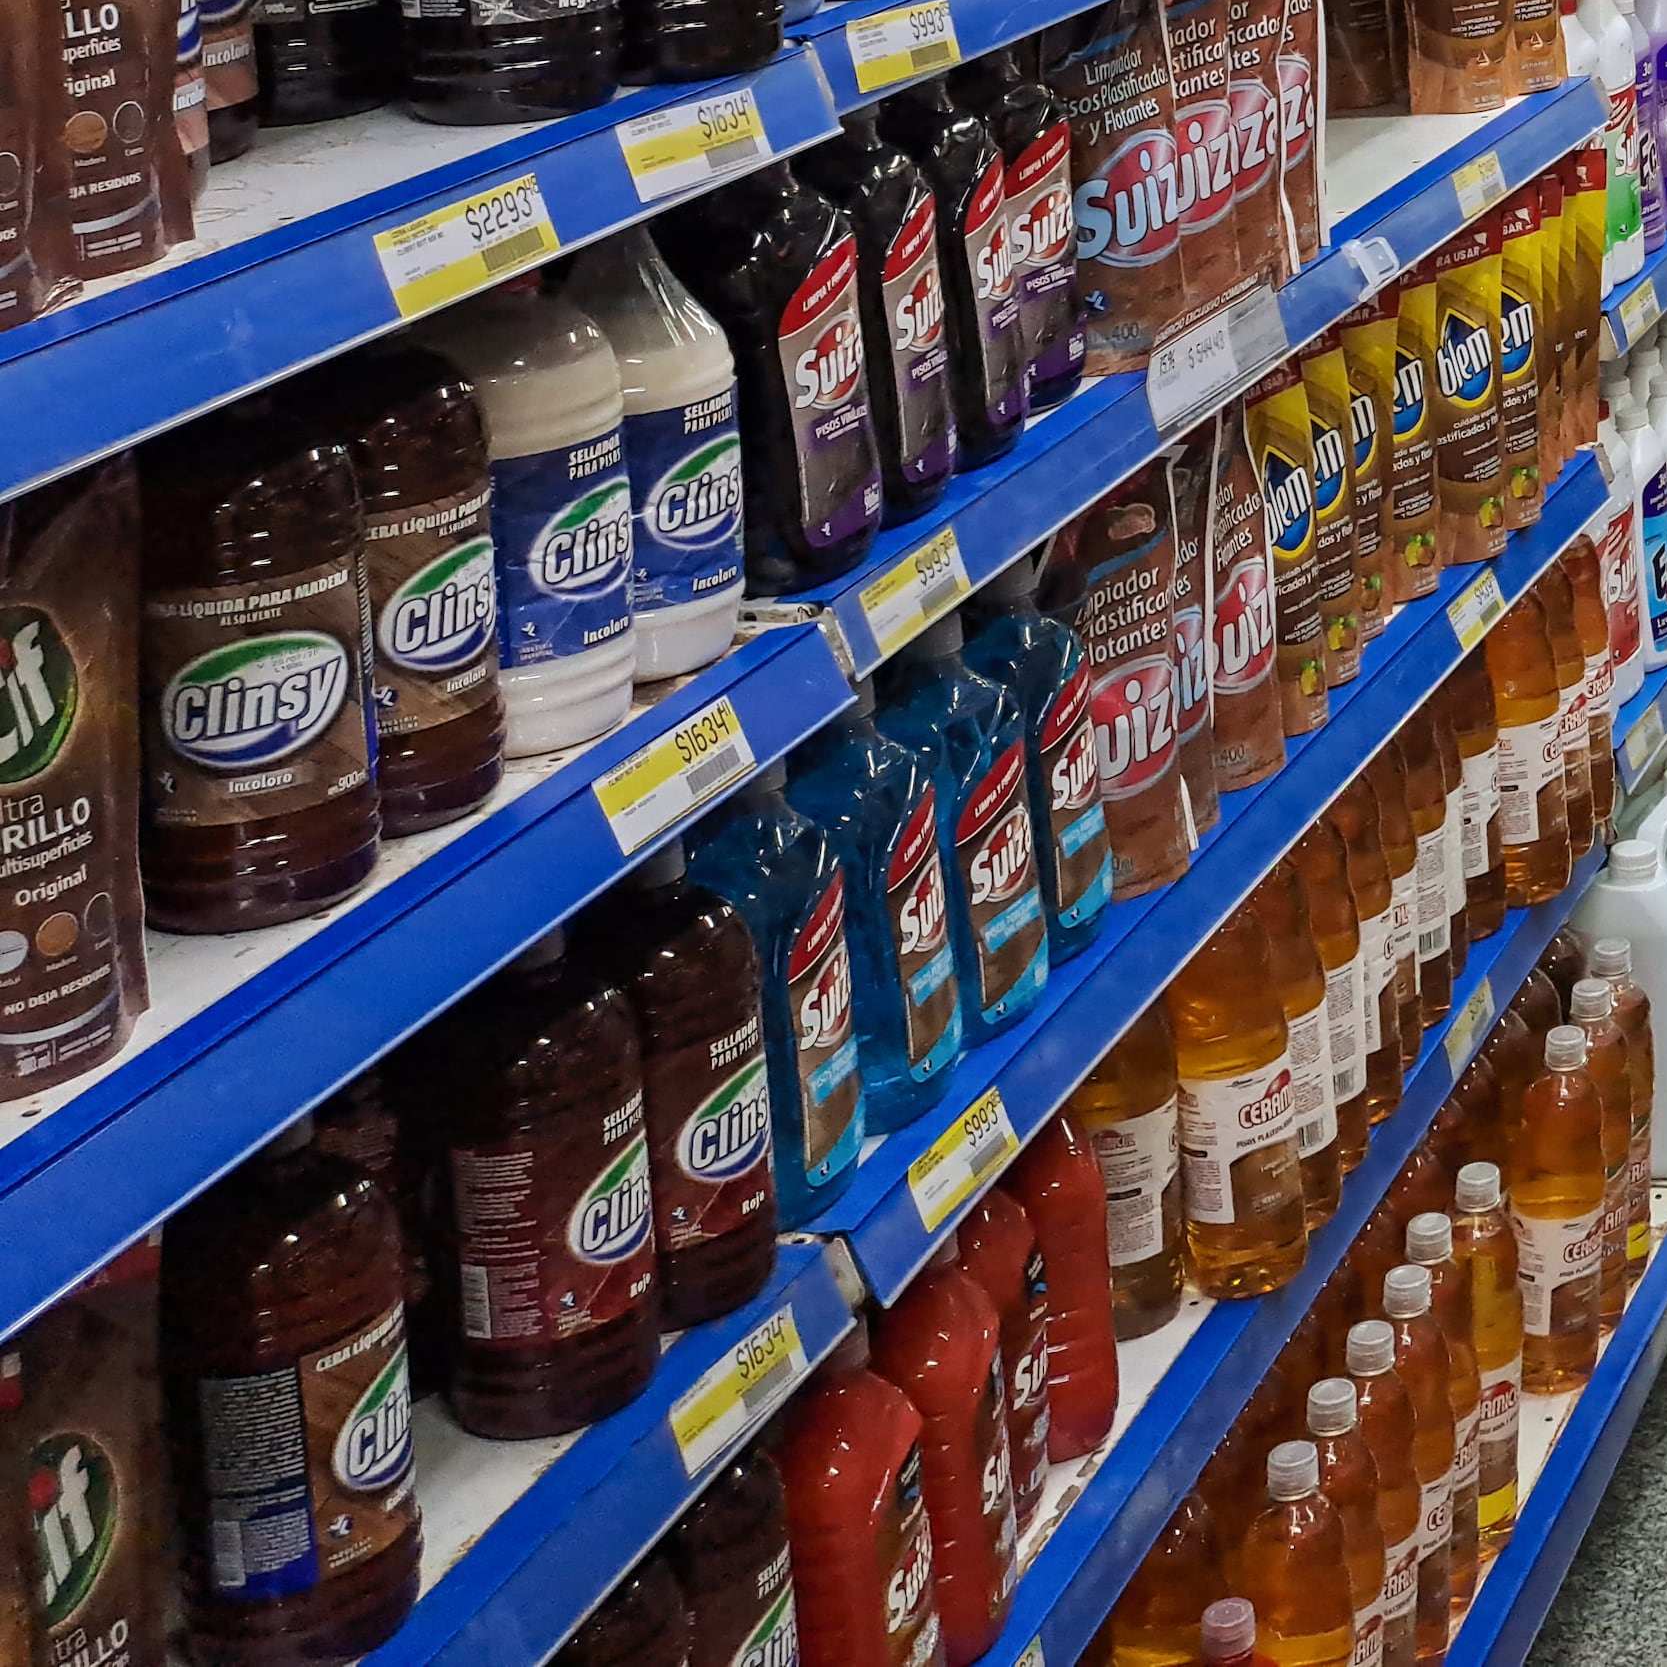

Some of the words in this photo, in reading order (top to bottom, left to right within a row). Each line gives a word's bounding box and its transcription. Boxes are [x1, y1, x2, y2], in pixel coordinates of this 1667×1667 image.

[1083, 46, 1143, 84] Limpiador
[1103, 96, 1160, 134] Flotantes
[88, 172, 142, 195] RESIDUOS
[1452, 247, 1481, 262] USAR
[1437, 329, 1492, 398] blem
[683, 391, 732, 422] SELLADOR
[684, 414, 711, 435] PARA
[712, 406, 732, 427] PISOS
[568, 433, 621, 466] SELLADOR
[569, 460, 598, 480] PARA
[599, 449, 622, 471] PISOS
[1266, 465, 1311, 543] blem
[401, 509, 455, 537] LÍQUIDA
[249, 587, 292, 610] PARA
[293, 569, 348, 602] MADERA
[691, 565, 738, 593] Incoloro
[236, 607, 282, 624] SOLVENTE
[582, 615, 629, 646] Incoloro
[446, 666, 486, 694] Incoloro
[168, 650, 344, 744] Clinsy
[227, 770, 293, 794] Incoloro
[15, 865, 88, 907] Original
[4, 996, 25, 1016] NO
[26, 987, 57, 1010] DEJA
[58, 963, 111, 1002] RESIDUOS
[709, 1017, 758, 1057] SELLADOR
[711, 1048, 738, 1070] PARA
[1239, 1080, 1295, 1128] CERAM
[742, 1191, 765, 1215] Rojo
